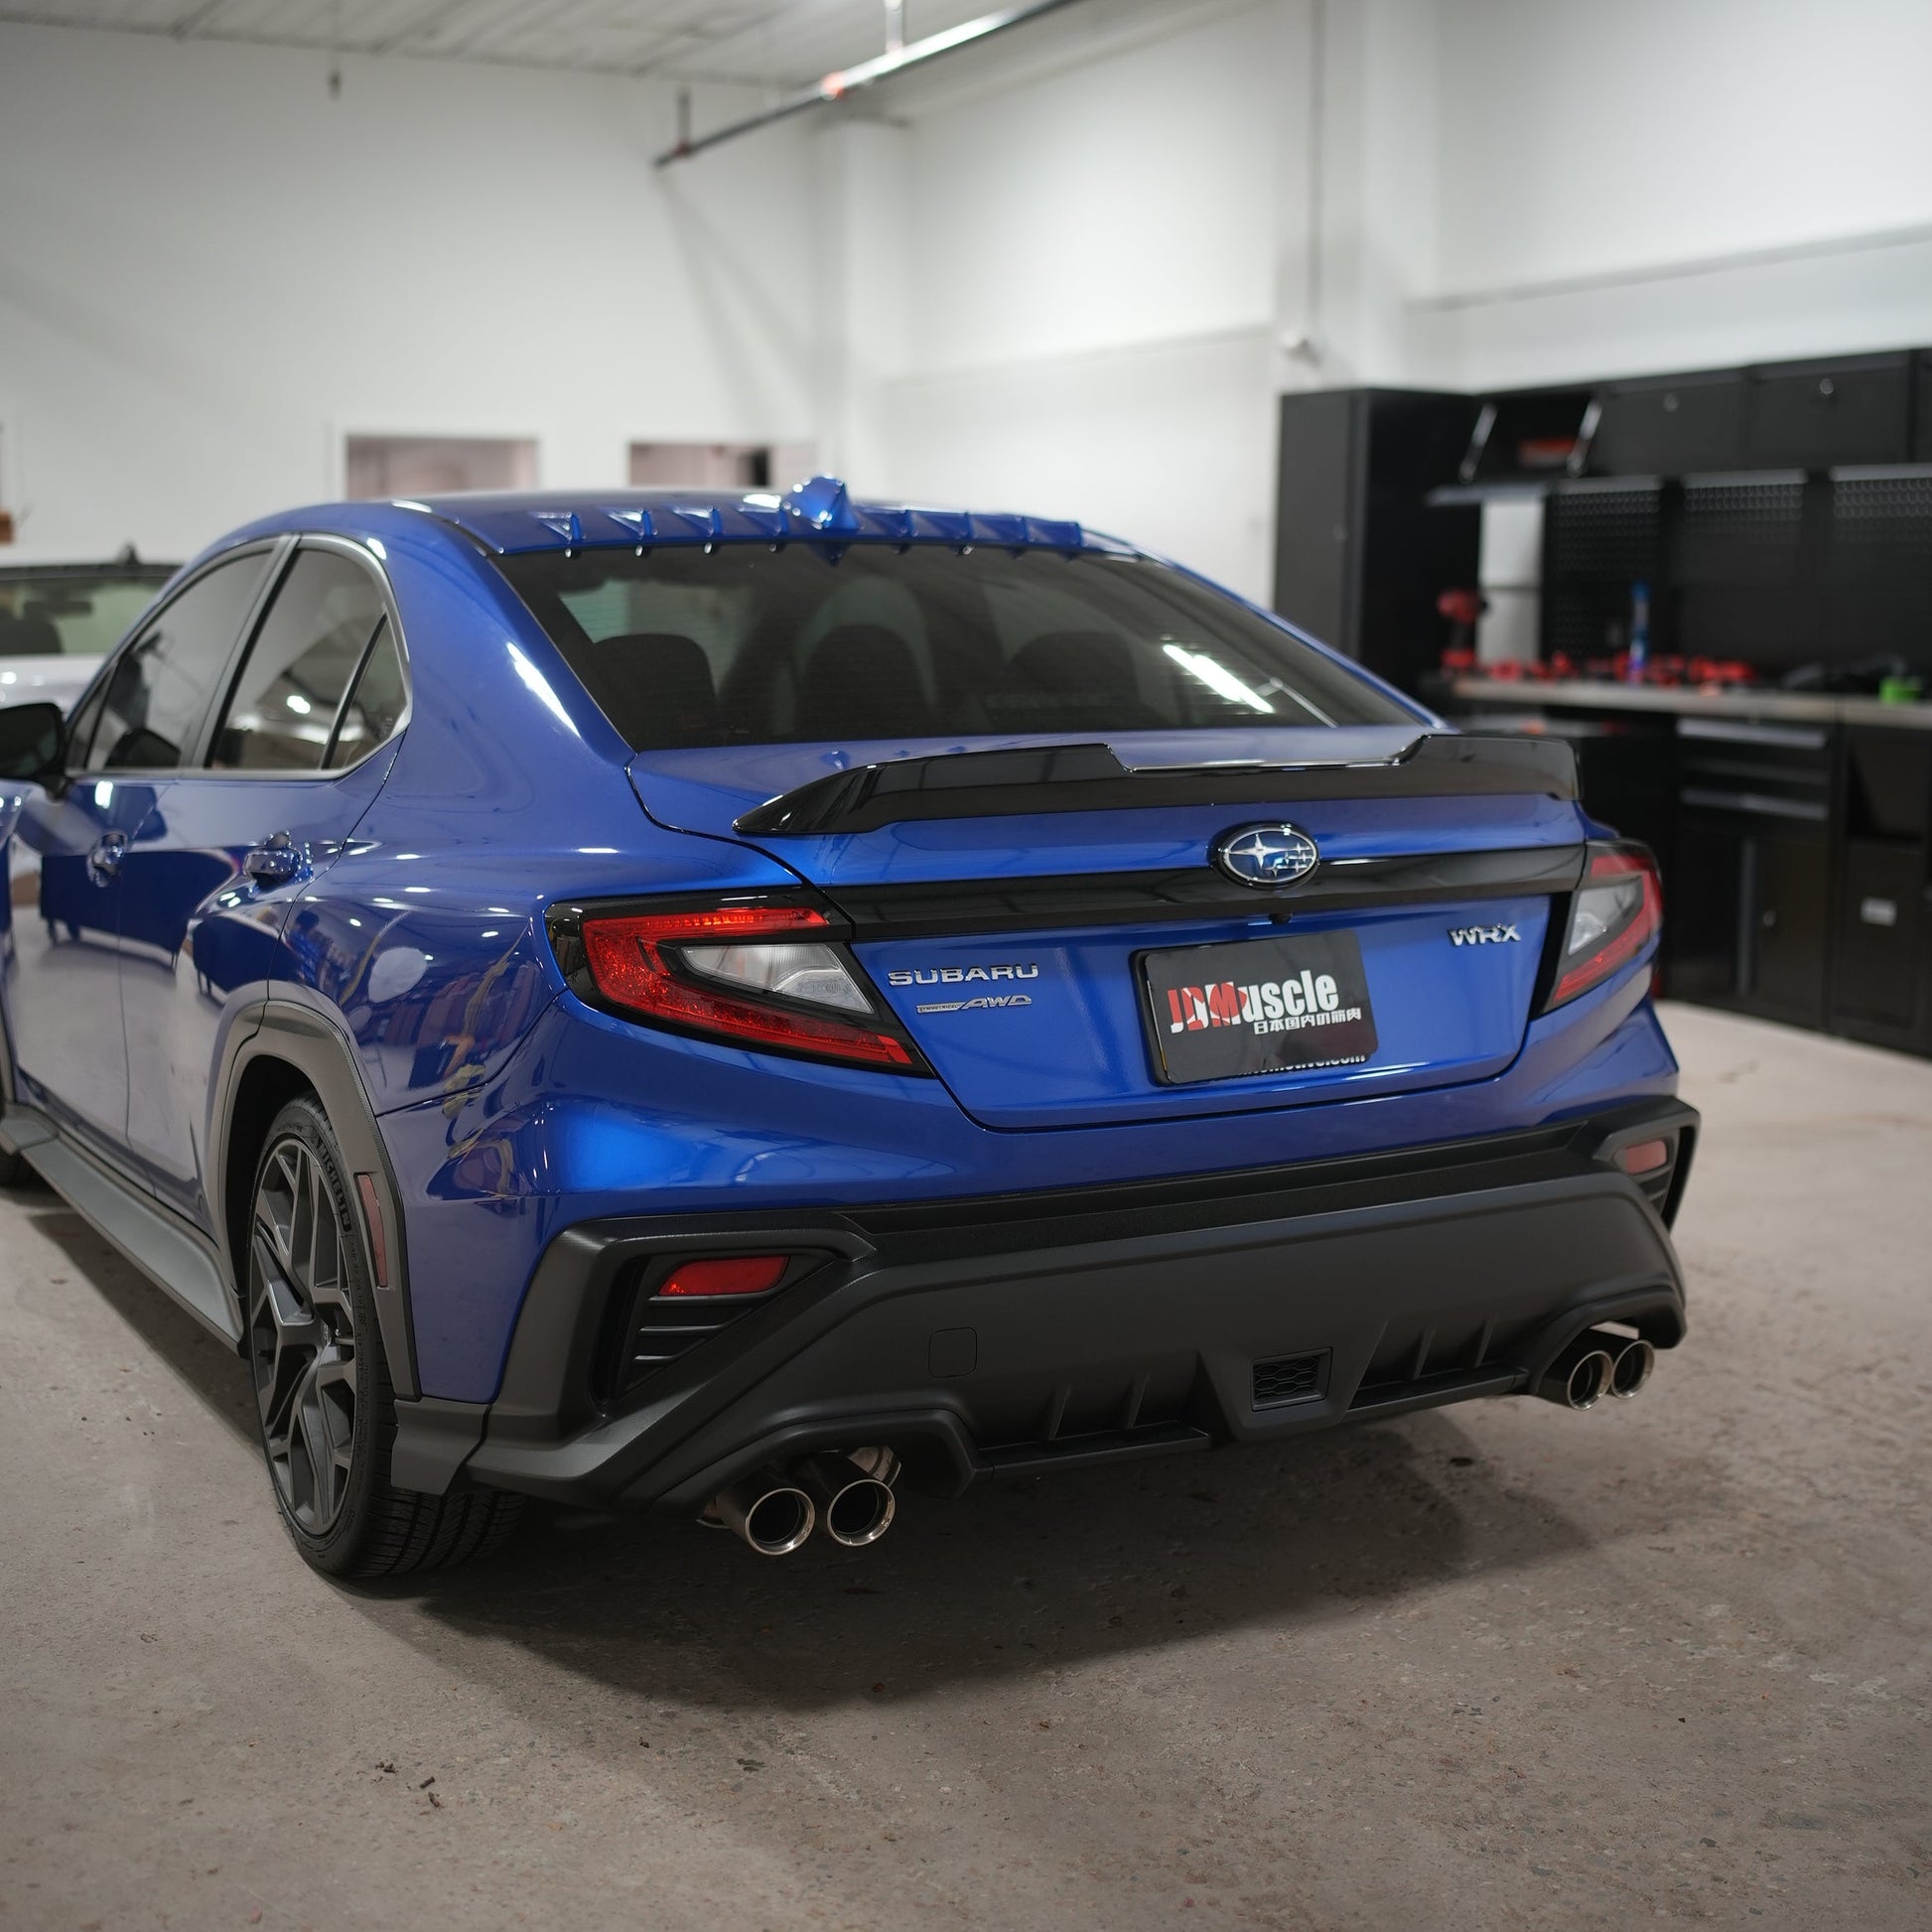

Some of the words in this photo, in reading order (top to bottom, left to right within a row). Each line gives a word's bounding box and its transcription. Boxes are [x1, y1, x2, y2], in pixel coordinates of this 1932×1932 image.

[1449, 923, 1521, 946] WRX
[889, 964, 1038, 986] SUBARU
[962, 995, 1033, 1010] AWD
[1168, 970, 1339, 1034] JDMuscle
[315, 1141, 350, 1227] MICHELIN
